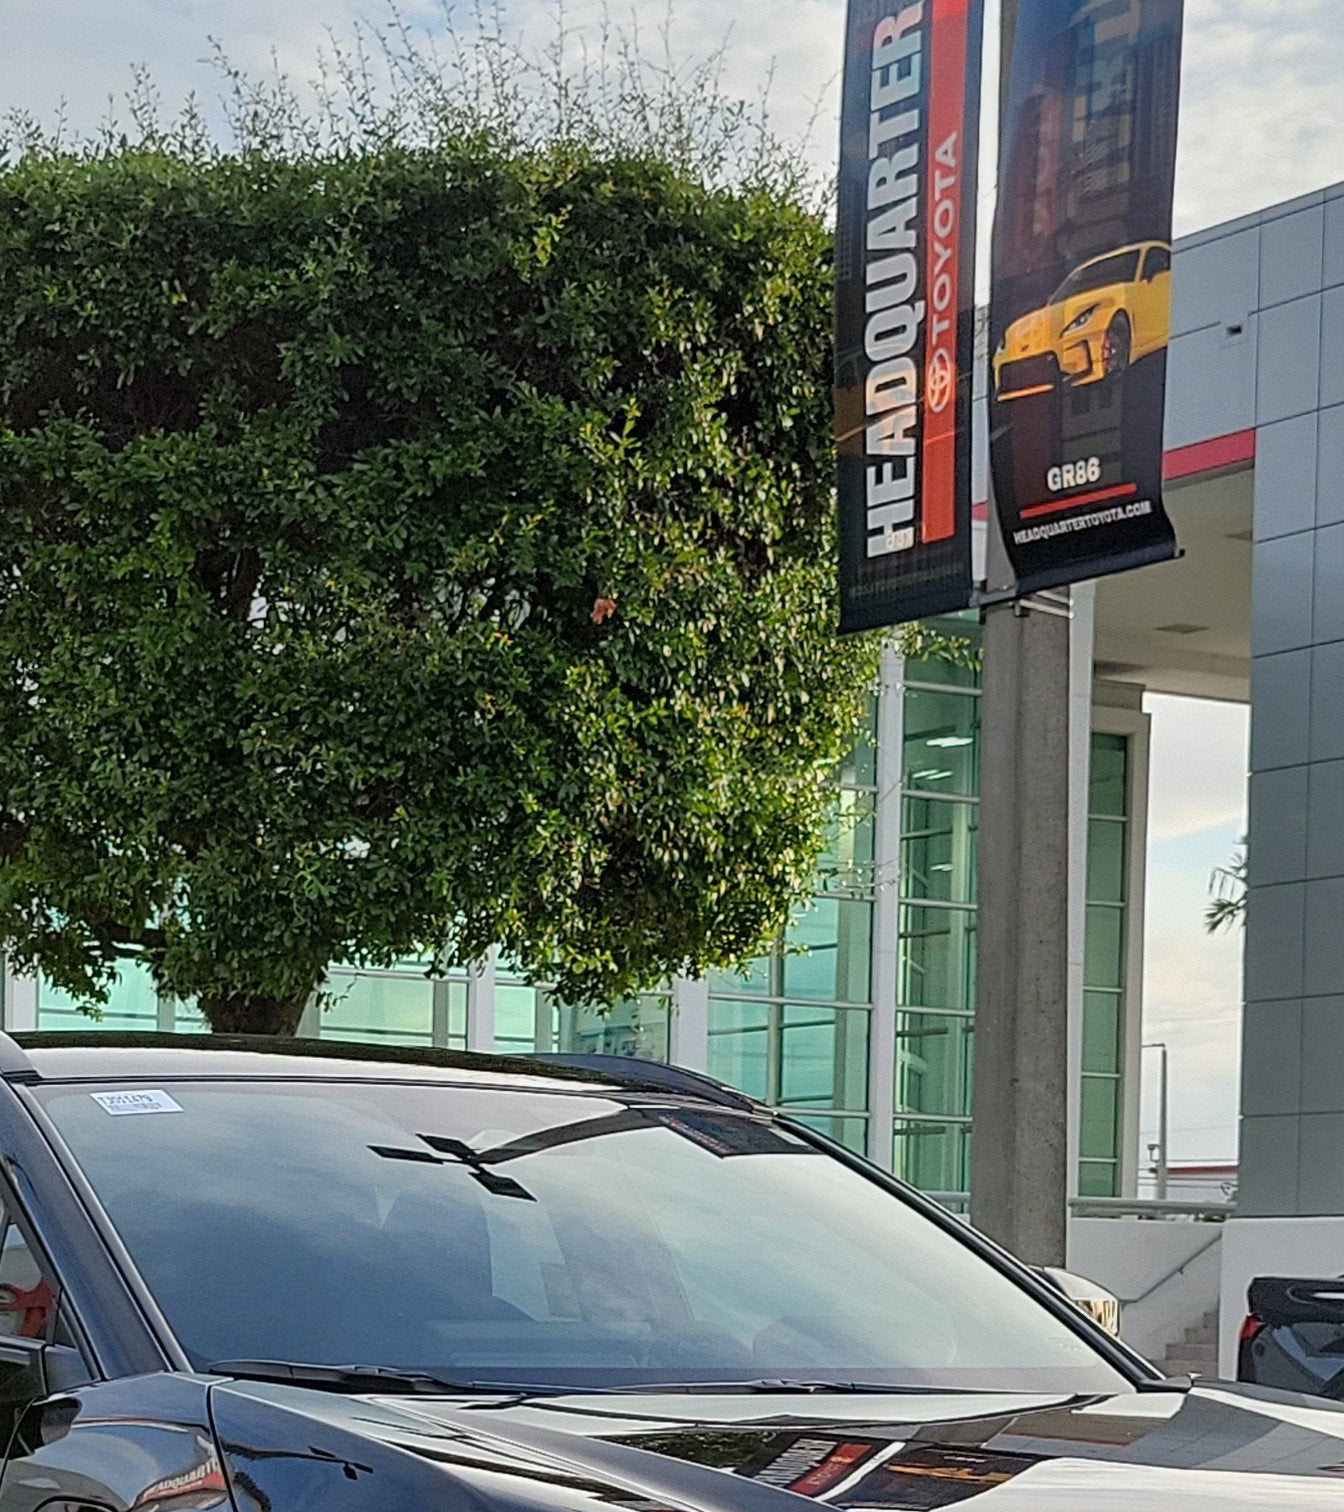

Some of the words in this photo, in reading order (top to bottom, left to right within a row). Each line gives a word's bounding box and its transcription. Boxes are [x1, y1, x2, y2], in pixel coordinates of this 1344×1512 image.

[863, 0, 924, 558] HEADQUARTER
[931, 131, 959, 346] TOYOTA
[1013, 500, 1152, 545] HEADQUARTERTOYOTA.COM
[1047, 457, 1100, 491] GR86
